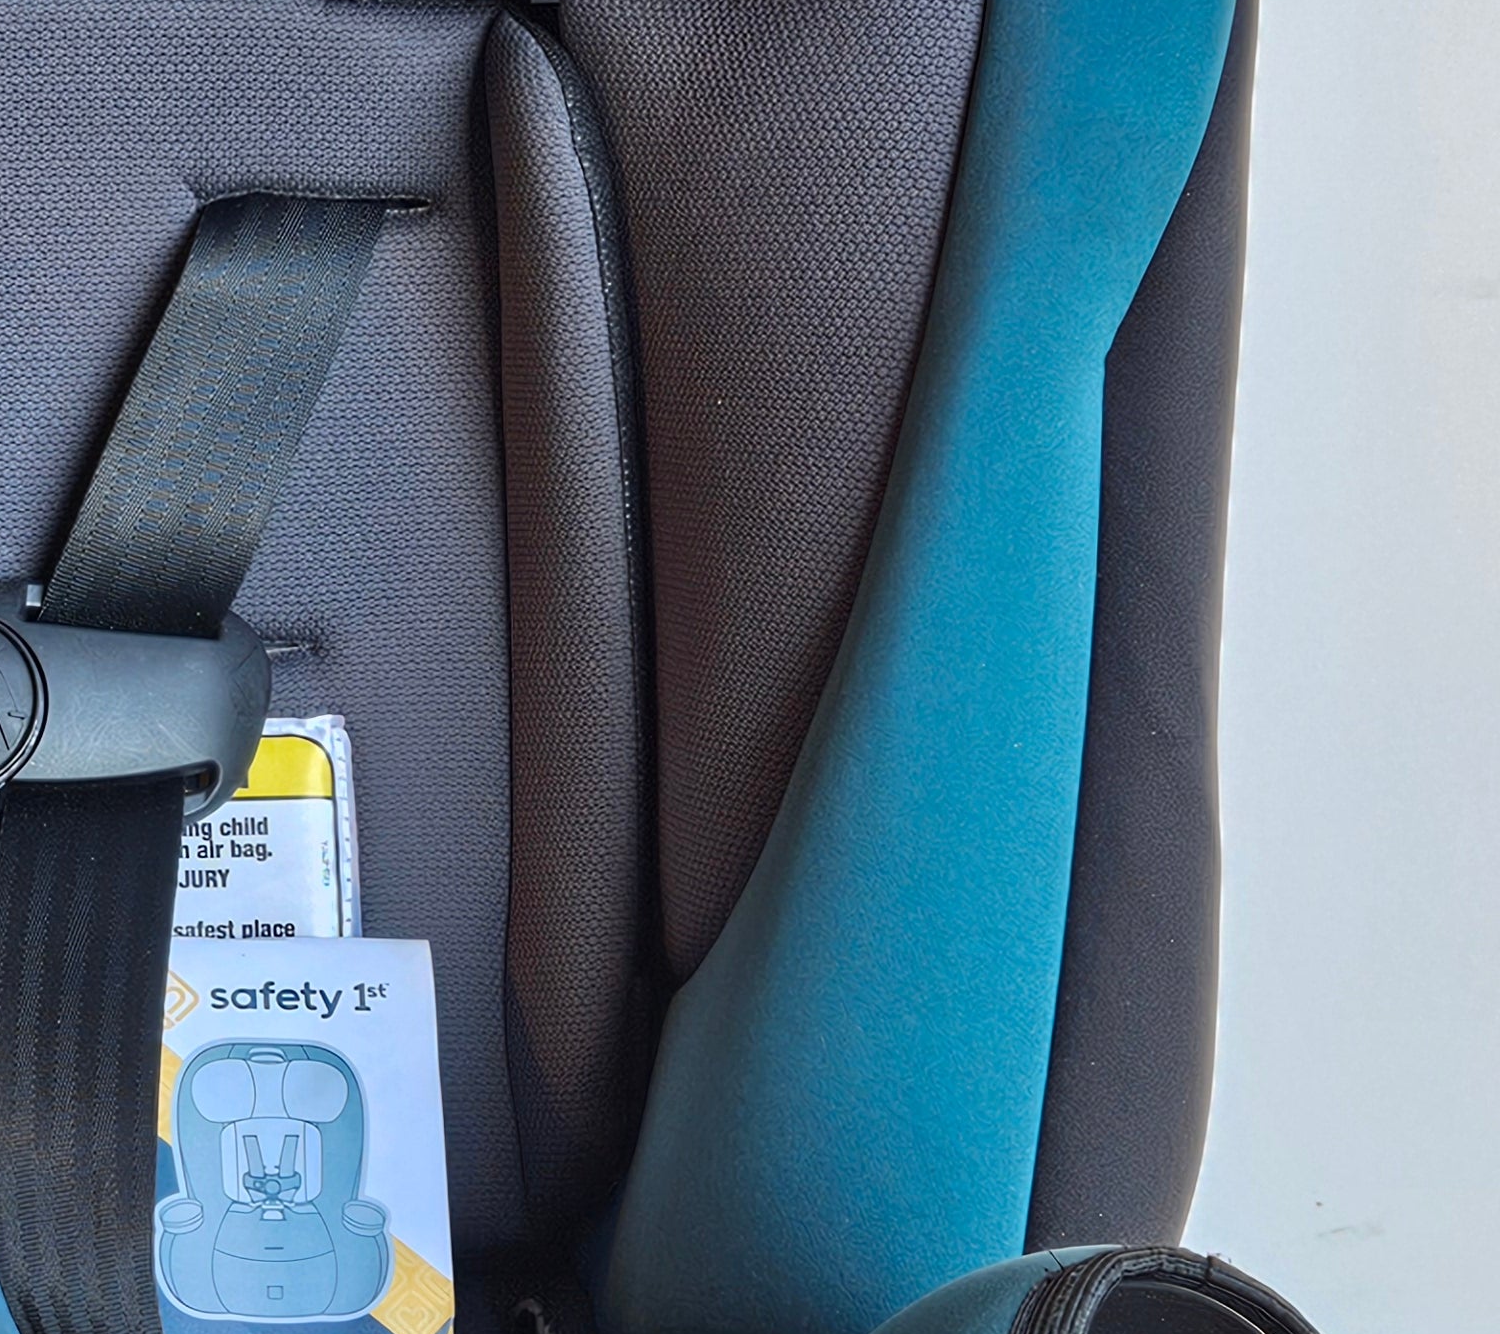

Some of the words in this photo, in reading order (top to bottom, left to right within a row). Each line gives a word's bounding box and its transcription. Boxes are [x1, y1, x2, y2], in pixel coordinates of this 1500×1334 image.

[219, 817, 269, 837] child
[197, 840, 223, 859] air
[231, 840, 273, 861] bag.
[179, 869, 230, 888] JURY
[174, 920, 235, 939] safest
[242, 920, 296, 939] place
[210, 981, 343, 1019] safety
[353, 982, 388, 1011] 1st
